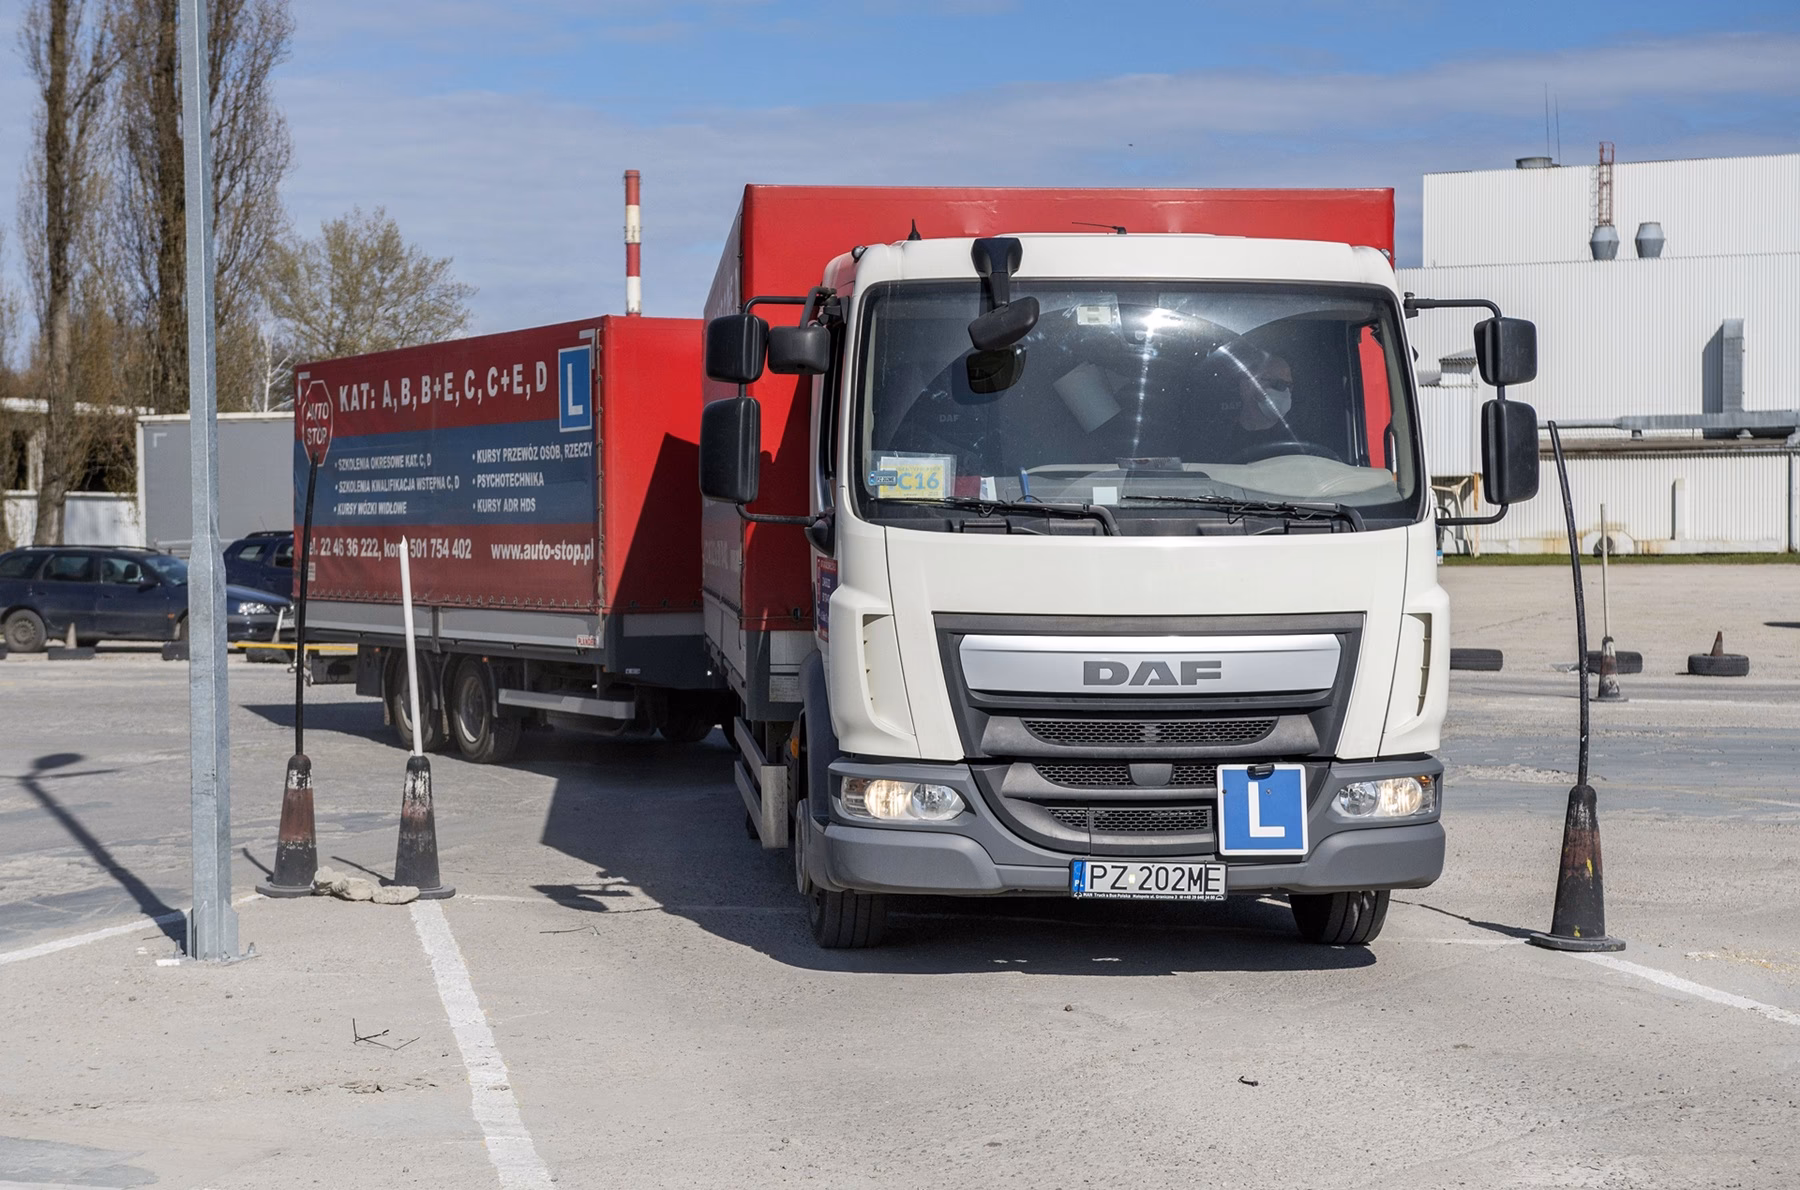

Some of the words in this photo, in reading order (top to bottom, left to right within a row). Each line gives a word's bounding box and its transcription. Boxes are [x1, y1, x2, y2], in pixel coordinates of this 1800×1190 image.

[339, 382, 375, 412] KAT:
[382, 380, 397, 413] A,
[401, 377, 417, 411] B,
[421, 372, 460, 407] B+E,
[464, 369, 482, 405] C,
[487, 364, 531, 400] C+E,
[535, 361, 547, 392] D
[567, 363, 583, 416] L
[306, 402, 329, 420] AUTO
[939, 414, 960, 422] DAF
[306, 427, 327, 445] STOP
[476, 448, 501, 463] KURSY
[502, 443, 539, 462] PRZEWÓZ
[564, 441, 593, 458] RZECZY
[338, 457, 370, 471] SZKOLENIA
[370, 455, 404, 469] OKRESOWE
[338, 480, 370, 493] SZKOLENIA
[371, 478, 415, 492] KWALIFIKACJA
[476, 472, 544, 488] PSYCHOTECHNIKA
[897, 472, 939, 490] C16
[337, 502, 357, 515] KURSY
[477, 499, 501, 513] KURSY
[502, 498, 519, 512] ADR
[520, 497, 536, 512] HDS
[320, 537, 331, 556] 22
[332, 538, 344, 556] 46
[346, 538, 358, 557] 36
[410, 538, 427, 558] 501
[430, 538, 449, 559] 754
[452, 538, 472, 559] 402
[491, 538, 594, 566] www.auto-stop.pl
[1083, 661, 1222, 686] DAF
[1248, 781, 1285, 837] L
[1090, 864, 1128, 890] PZ
[1138, 866, 1221, 892] 202ME
